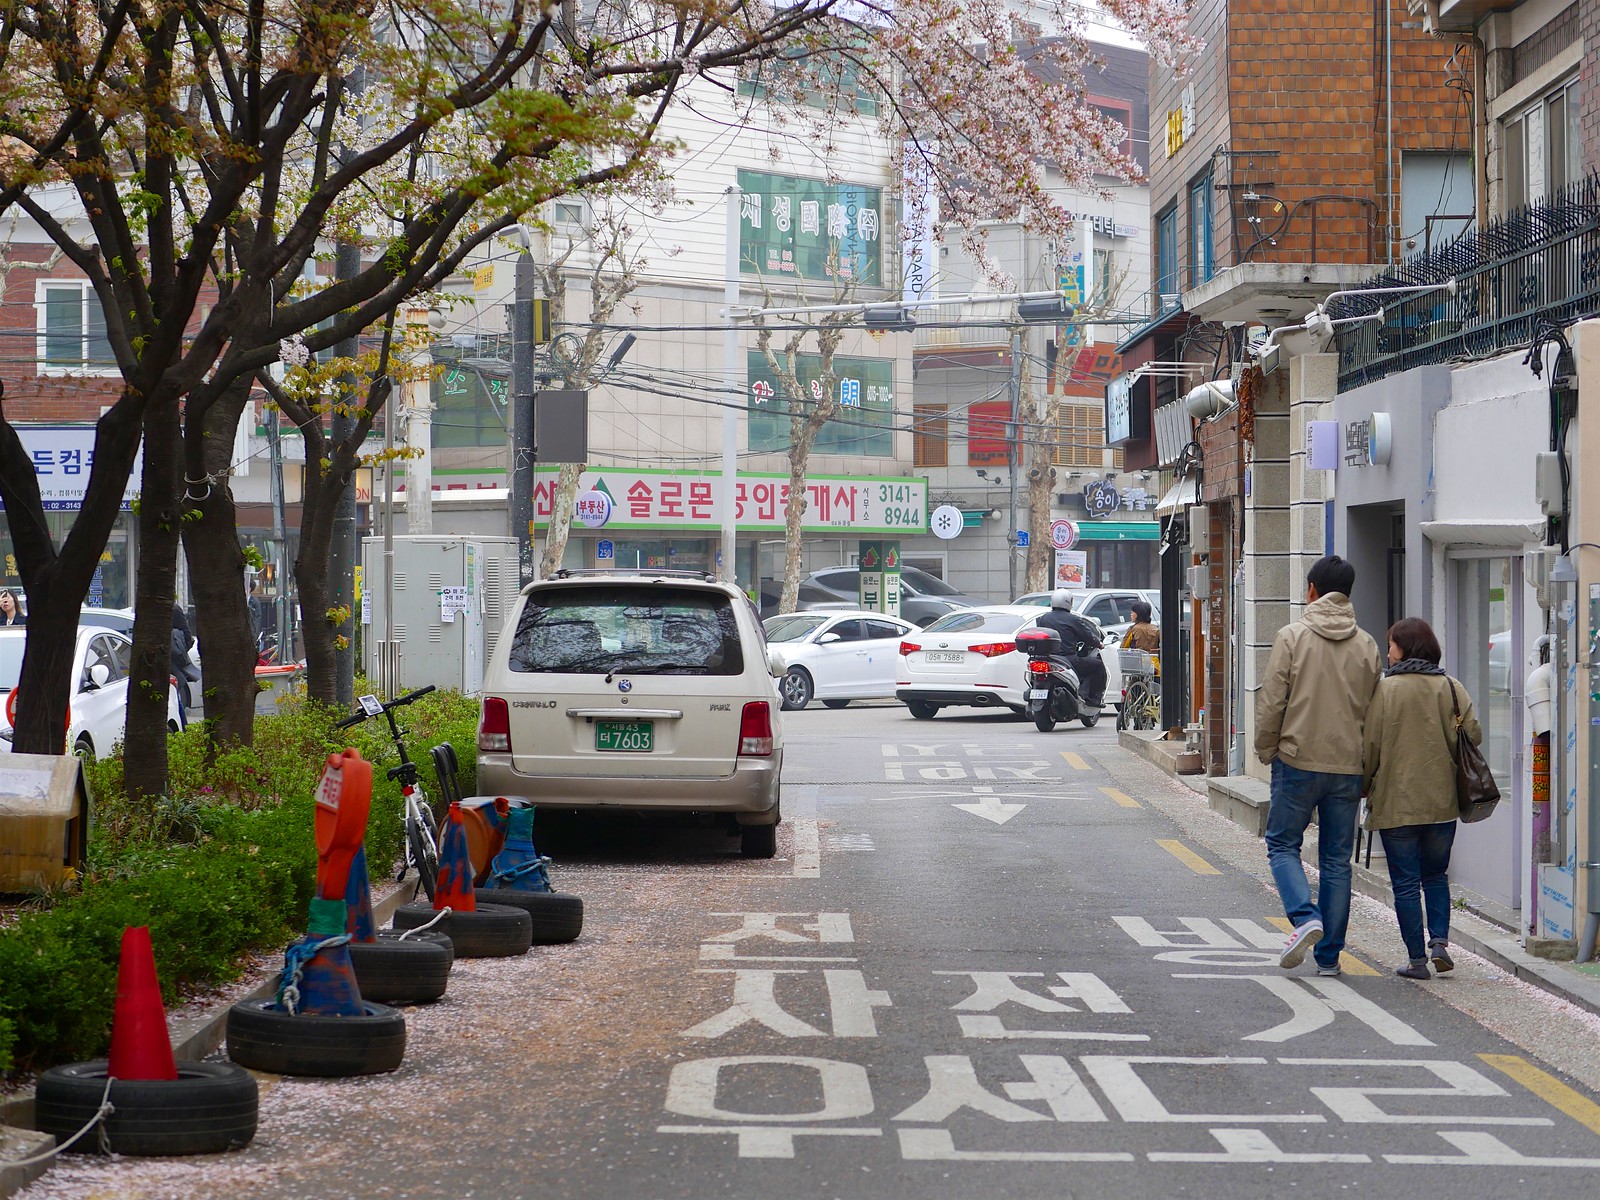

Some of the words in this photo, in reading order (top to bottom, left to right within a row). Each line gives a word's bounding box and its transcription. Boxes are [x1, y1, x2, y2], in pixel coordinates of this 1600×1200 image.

[579, 500, 605, 514] 부동산
[627, 479, 714, 520] 솔로몬
[885, 508, 920, 526] 8944
[626, 723, 639, 732] 43
[612, 732, 650, 749] 7603
[656, 1055, 1600, 1168] 우선도로
